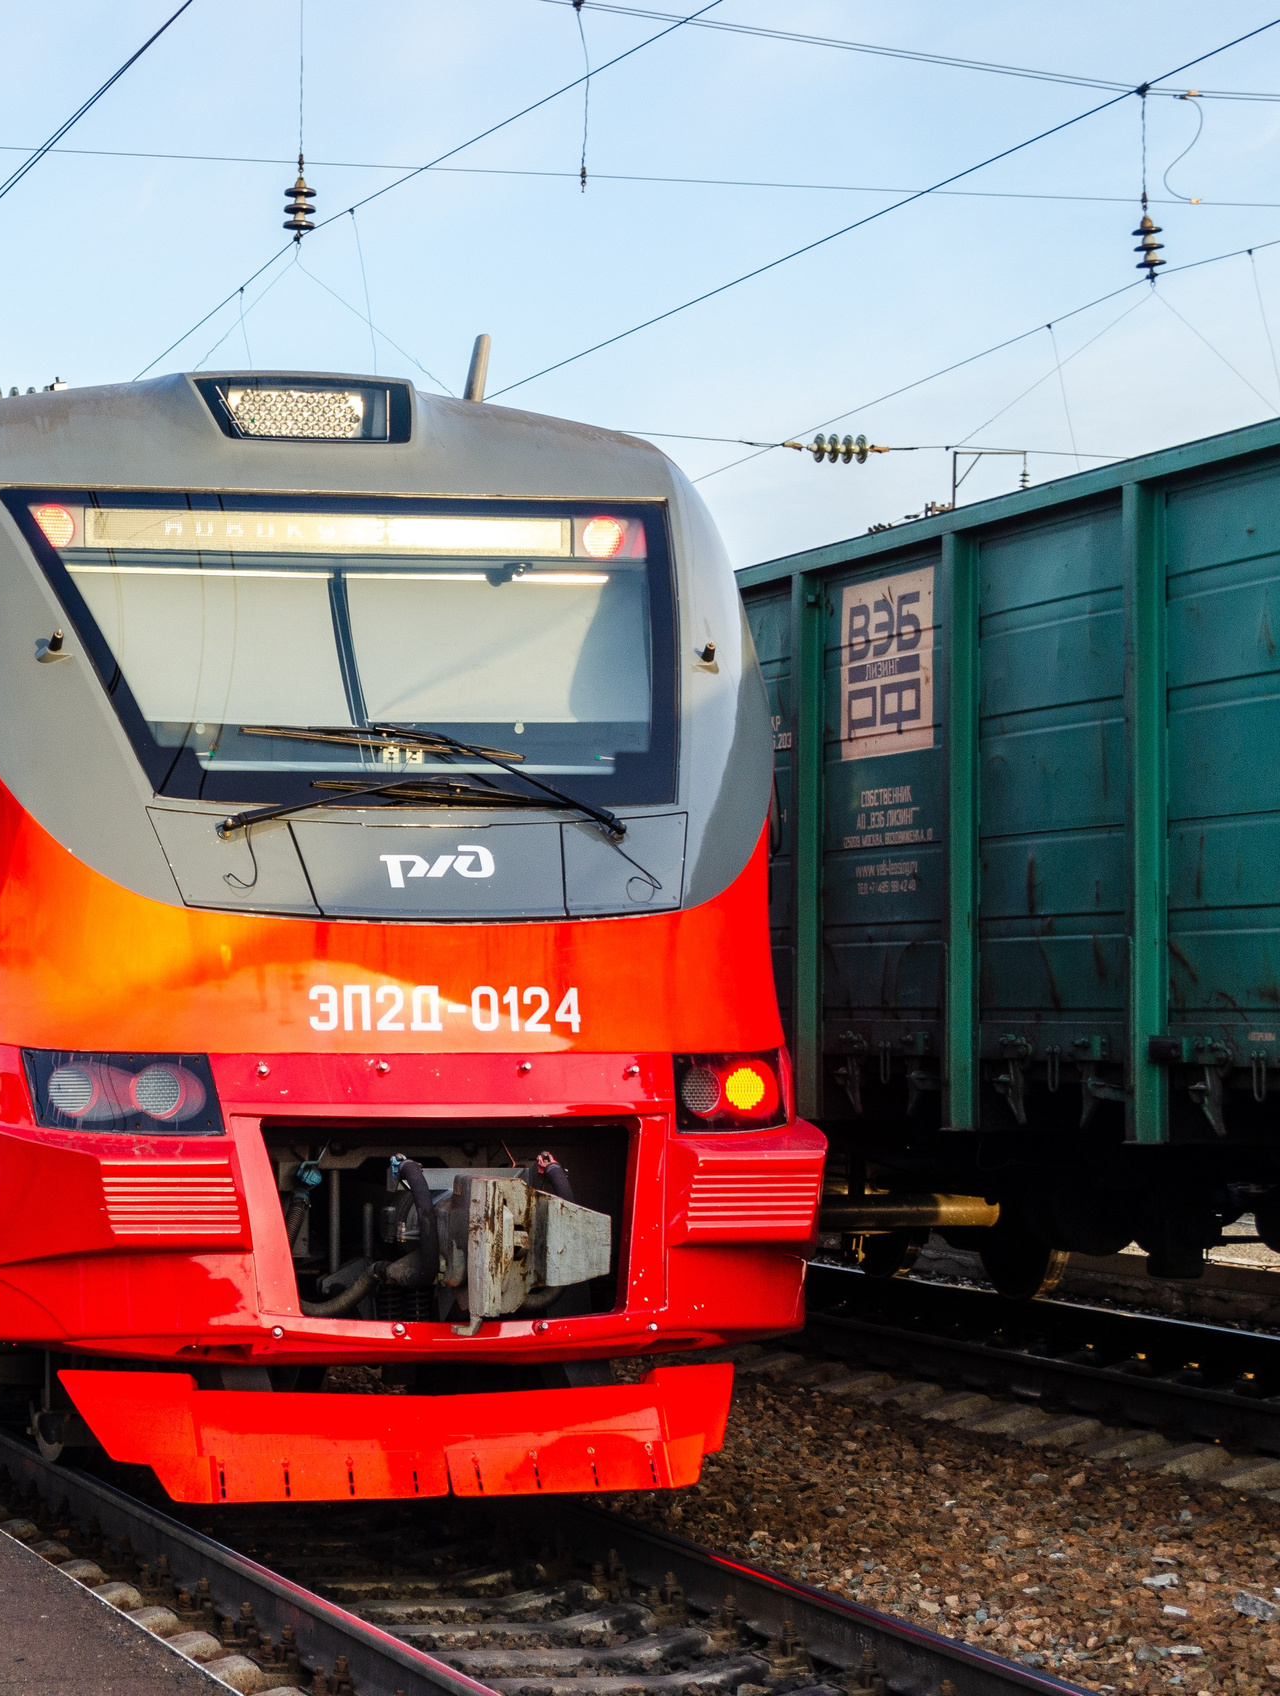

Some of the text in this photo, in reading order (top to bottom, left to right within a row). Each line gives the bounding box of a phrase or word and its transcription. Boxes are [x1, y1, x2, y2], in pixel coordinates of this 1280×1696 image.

[849, 591, 921, 663] ВЭБ
[865, 658, 900, 681] ЛИЗИНГ
[848, 678, 921, 742] РФ
[860, 785, 913, 808] СОБСТВЕННИК
[308, 984, 582, 1034] ЭП2Д-0124
